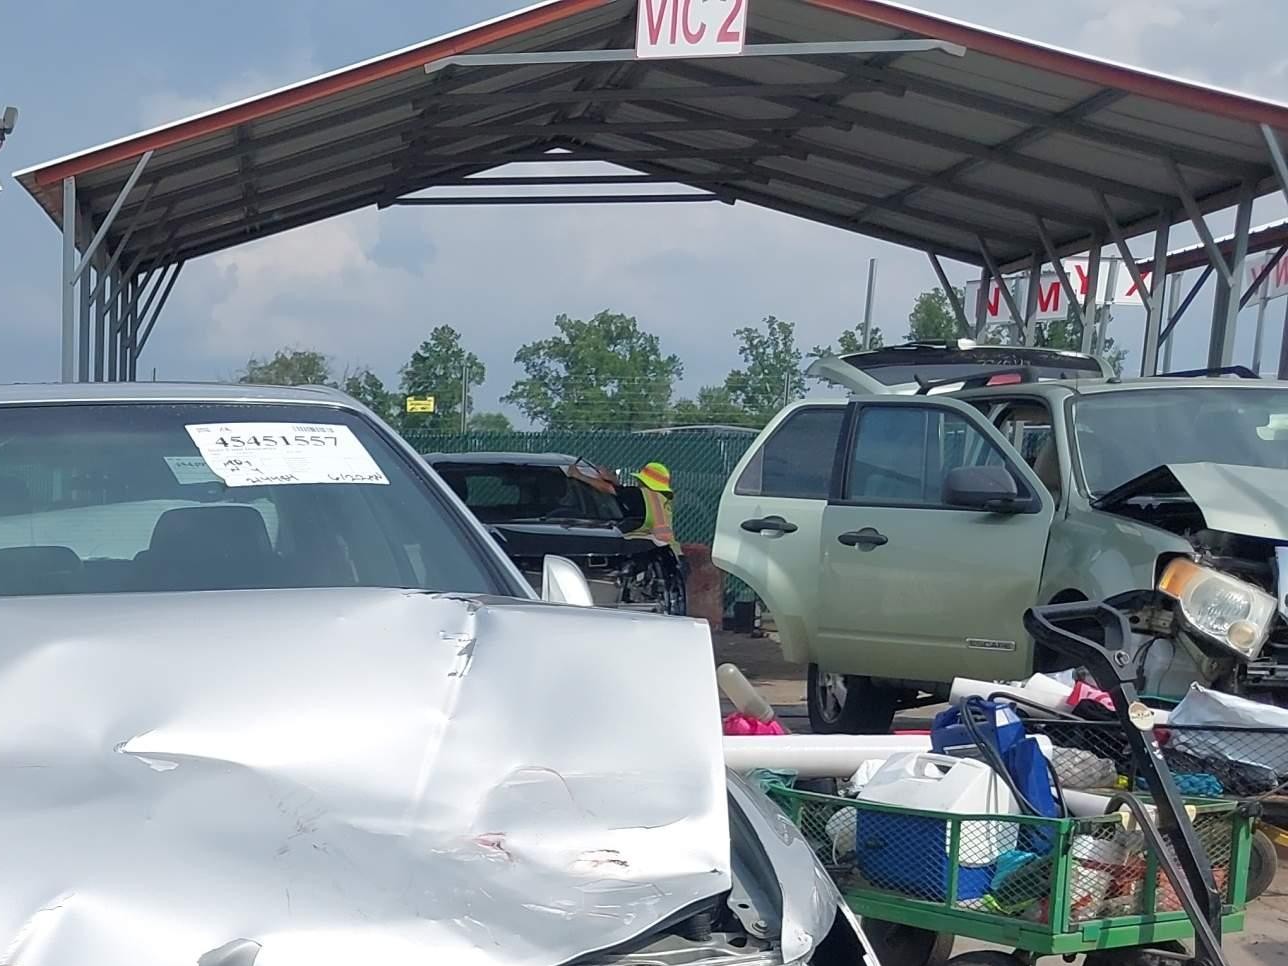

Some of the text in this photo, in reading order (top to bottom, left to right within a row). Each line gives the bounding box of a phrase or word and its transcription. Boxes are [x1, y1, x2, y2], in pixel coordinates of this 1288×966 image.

[645, 0, 744, 45] VIC 2
[215, 435, 338, 448] 45451557
